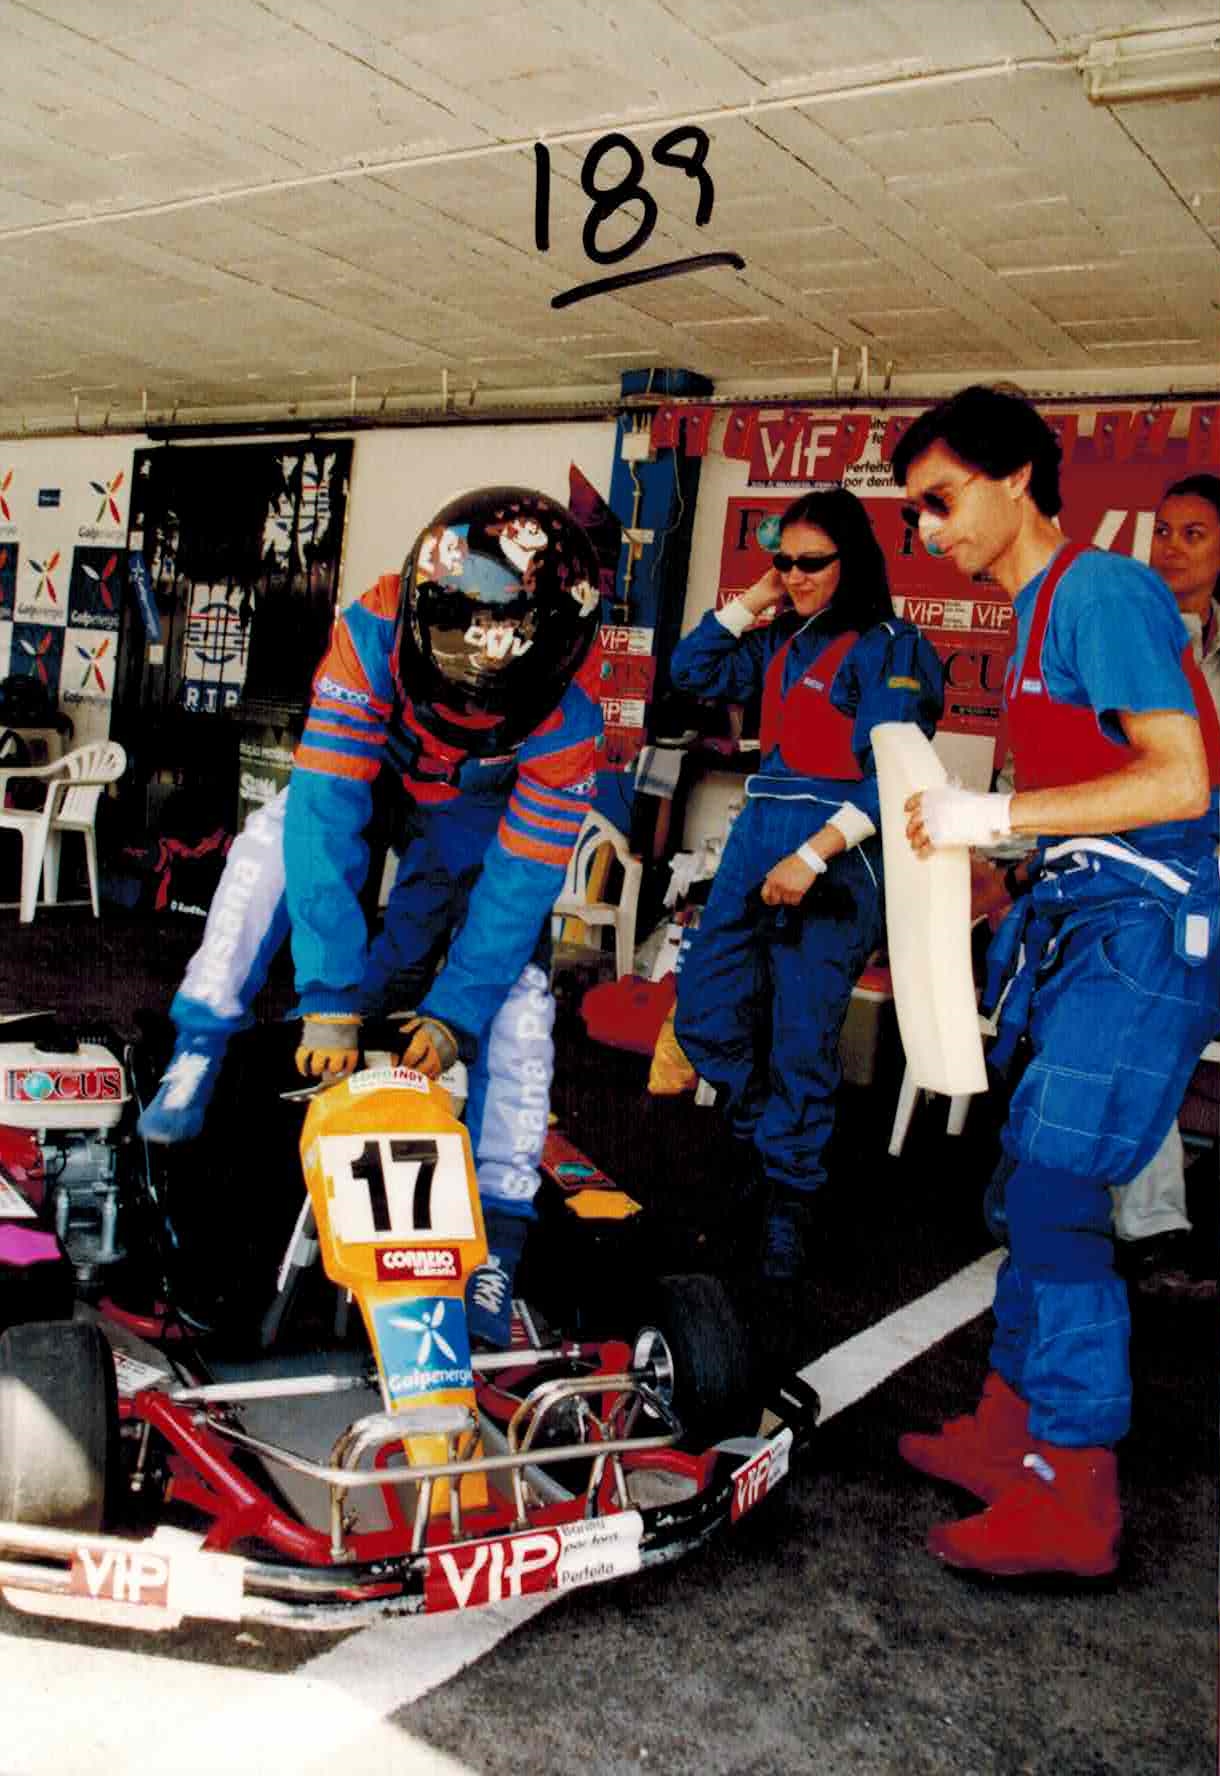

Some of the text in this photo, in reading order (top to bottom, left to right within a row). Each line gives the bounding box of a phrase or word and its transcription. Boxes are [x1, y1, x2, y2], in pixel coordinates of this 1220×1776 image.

[907, 602, 943, 624] VIP
[976, 604, 1013, 627] VIP
[600, 630, 629, 649] VIP
[603, 702, 620, 721] IP
[8, 1070, 121, 1101] FOCUS
[351, 1140, 438, 1232] 17
[738, 1457, 770, 1512] VIP
[77, 1549, 167, 1601] VIP
[438, 1534, 560, 1609] VIP
